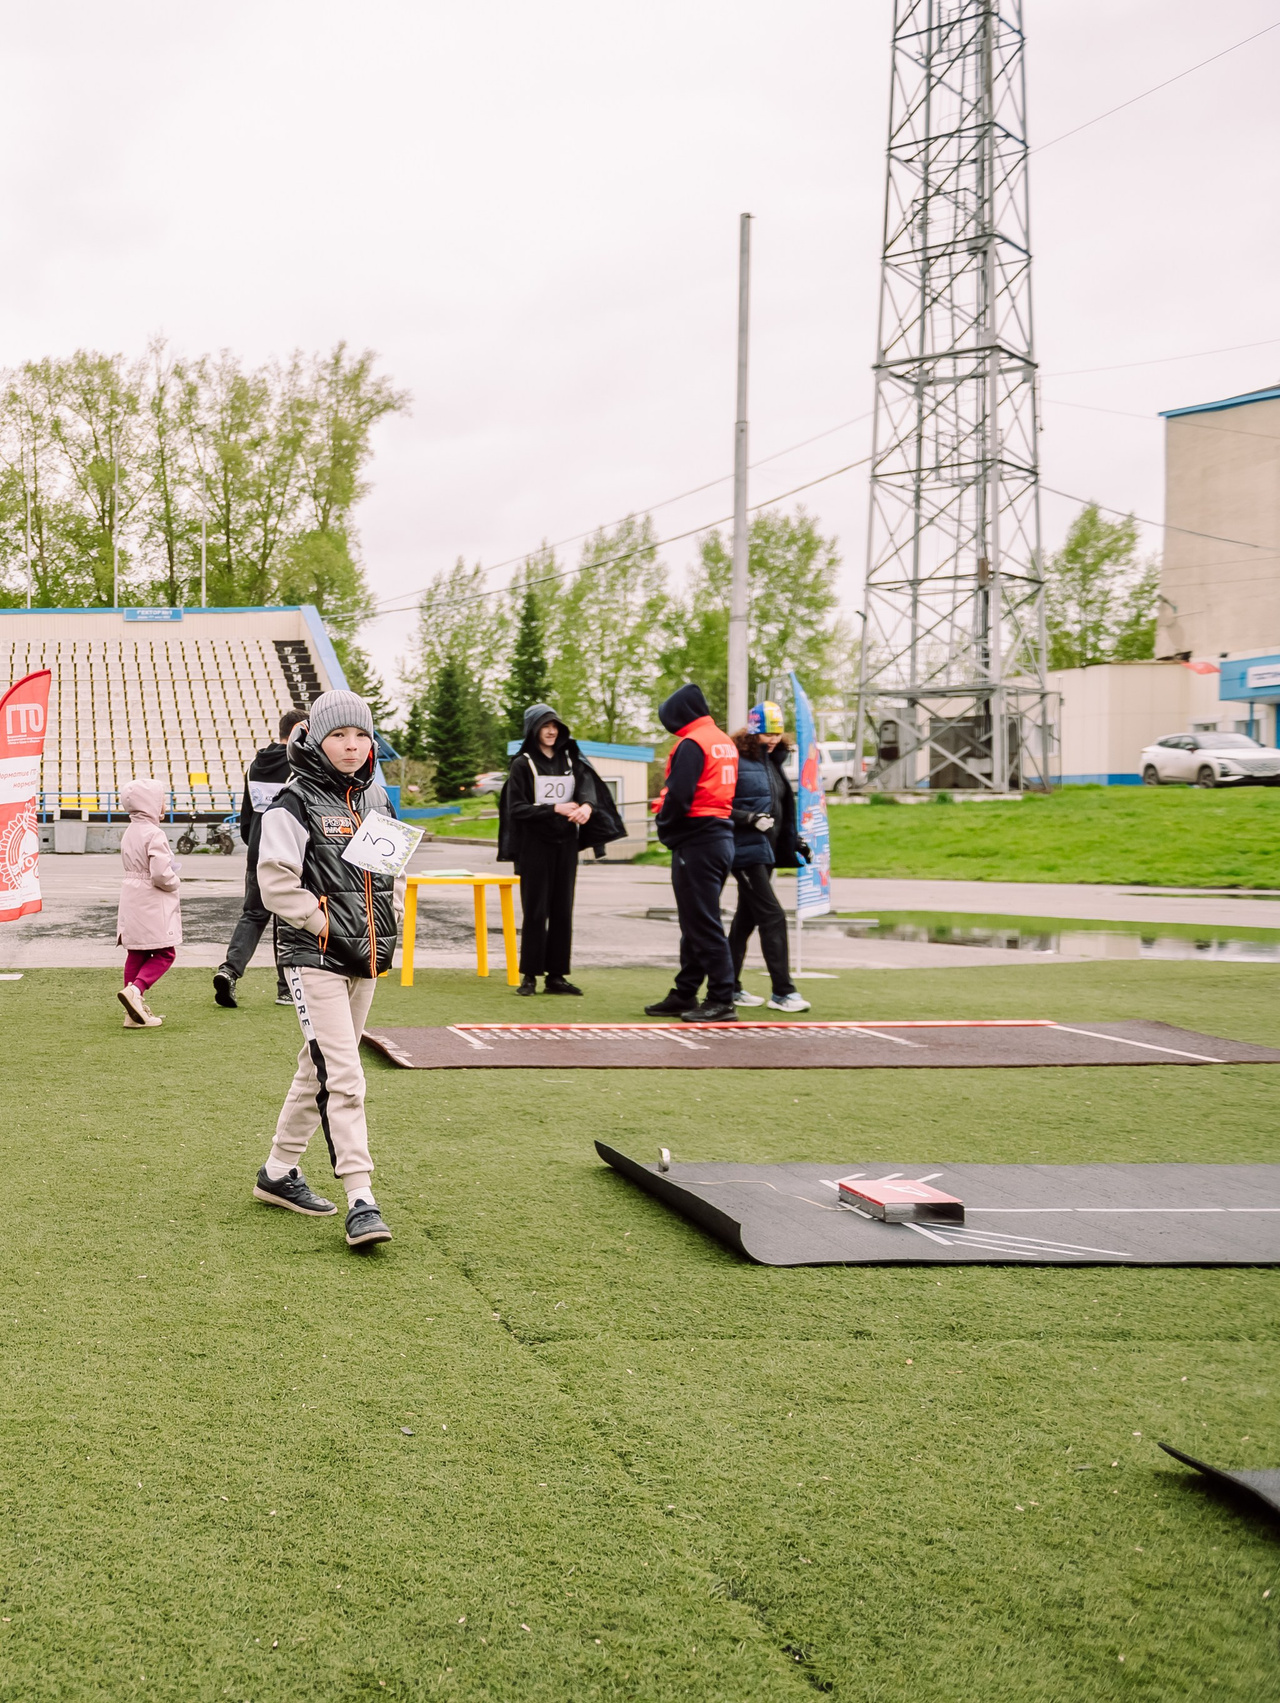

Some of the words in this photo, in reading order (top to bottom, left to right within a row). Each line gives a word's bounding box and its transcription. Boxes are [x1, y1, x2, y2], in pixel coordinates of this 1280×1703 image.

[300, 692, 309, 700] 12
[6, 703, 44, 735] ГТО
[544, 782, 566, 798] 20
[363, 832, 396, 857] 3
